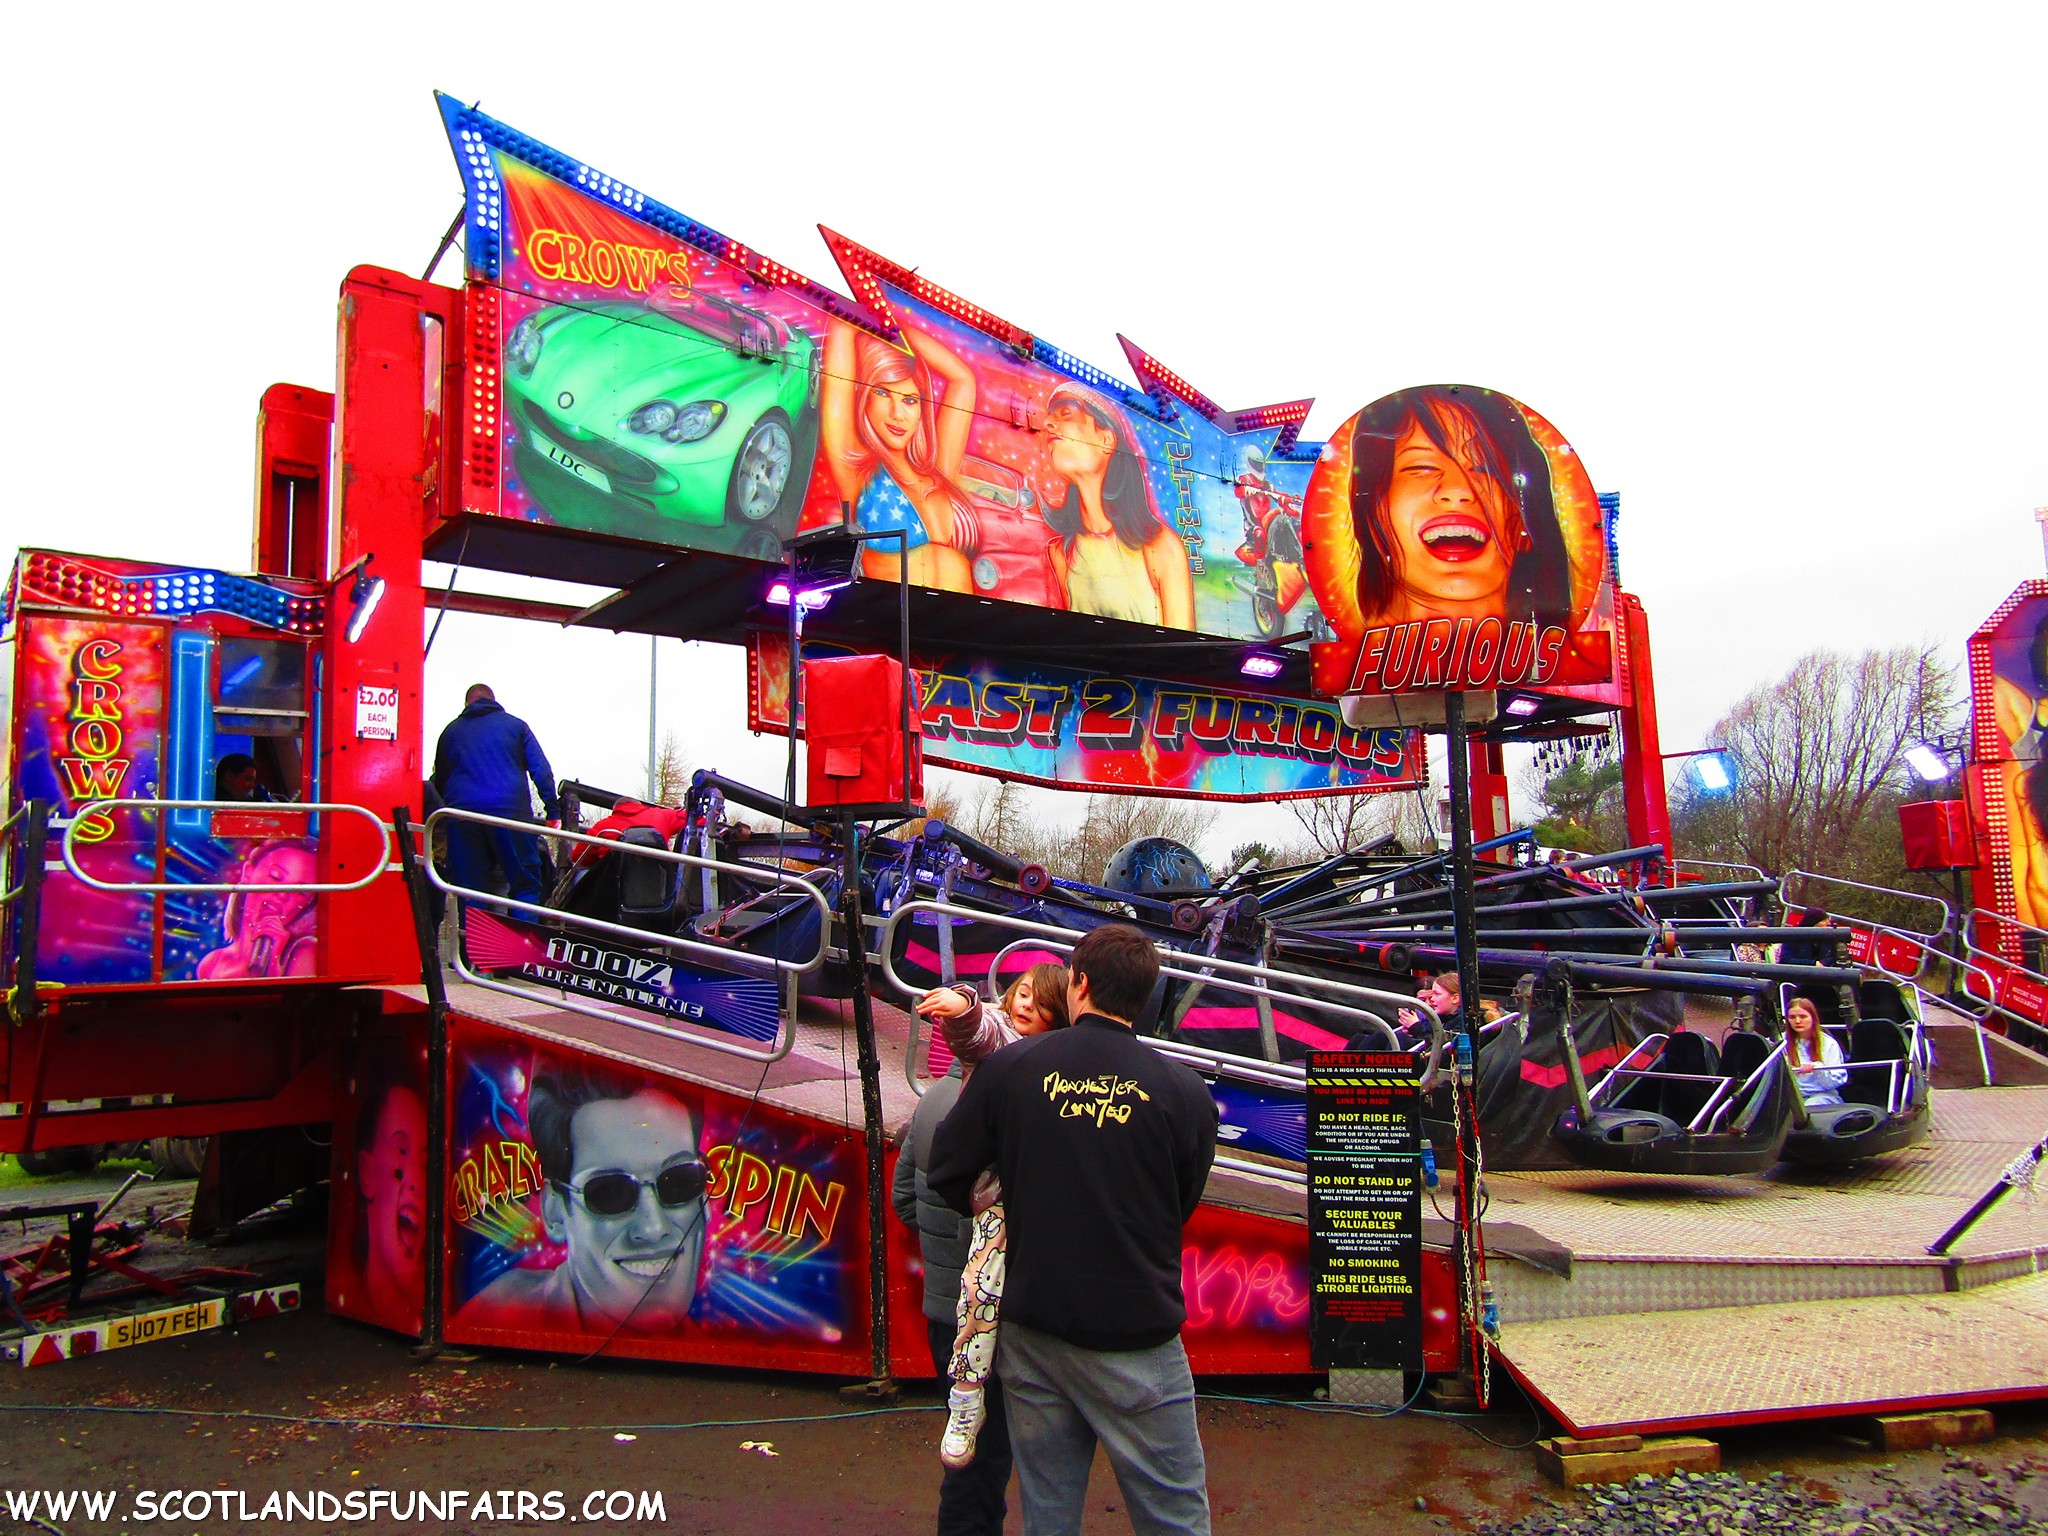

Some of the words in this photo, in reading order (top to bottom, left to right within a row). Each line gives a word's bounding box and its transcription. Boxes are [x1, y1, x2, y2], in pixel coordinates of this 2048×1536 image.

[528, 229, 691, 298] CROW'S
[549, 447, 587, 477] LDC
[1166, 442, 1205, 575] ULTIMATE
[1350, 617, 1566, 692] FURIOUS
[360, 690, 396, 707] £2.00
[367, 712, 387, 723] EACH
[1076, 678, 1138, 742] 2
[1153, 691, 1403, 769] FURIOUS
[61, 639, 130, 842] CROWS
[363, 726, 391, 736] PERSON
[547, 938, 673, 988] 100%
[522, 962, 704, 1018] ADRENALINE
[1312, 1054, 1362, 1064] SAFETY
[1365, 1054, 1413, 1064] NOTICE
[1320, 1113, 1335, 1122] DO
[1338, 1114, 1360, 1122] NOT
[1362, 1114, 1390, 1122] RIDE
[1392, 1114, 1406, 1122] IF:
[449, 1141, 543, 1222] CRAZY
[1315, 1176, 1330, 1184] DO
[1334, 1176, 1355, 1185] NOT
[1358, 1177, 1393, 1186] STAND
[1396, 1178, 1412, 1186] UP
[706, 1145, 844, 1241] SPIN
[1325, 1210, 1369, 1219] SECURE
[1372, 1211, 1402, 1220] YOUR
[1332, 1220, 1396, 1229] VALUABLES
[1329, 1258, 1344, 1267] NO
[1348, 1259, 1400, 1268] SMOKING
[1316, 1284, 1359, 1293] STROBE
[1362, 1285, 1412, 1294] LIGHTING
[1322, 1275, 1346, 1283] THIS
[1349, 1275, 1376, 1283] RIDE
[1379, 1275, 1407, 1284] USES
[118, 1317, 167, 1342] SJ07
[173, 1308, 208, 1331] FEH
